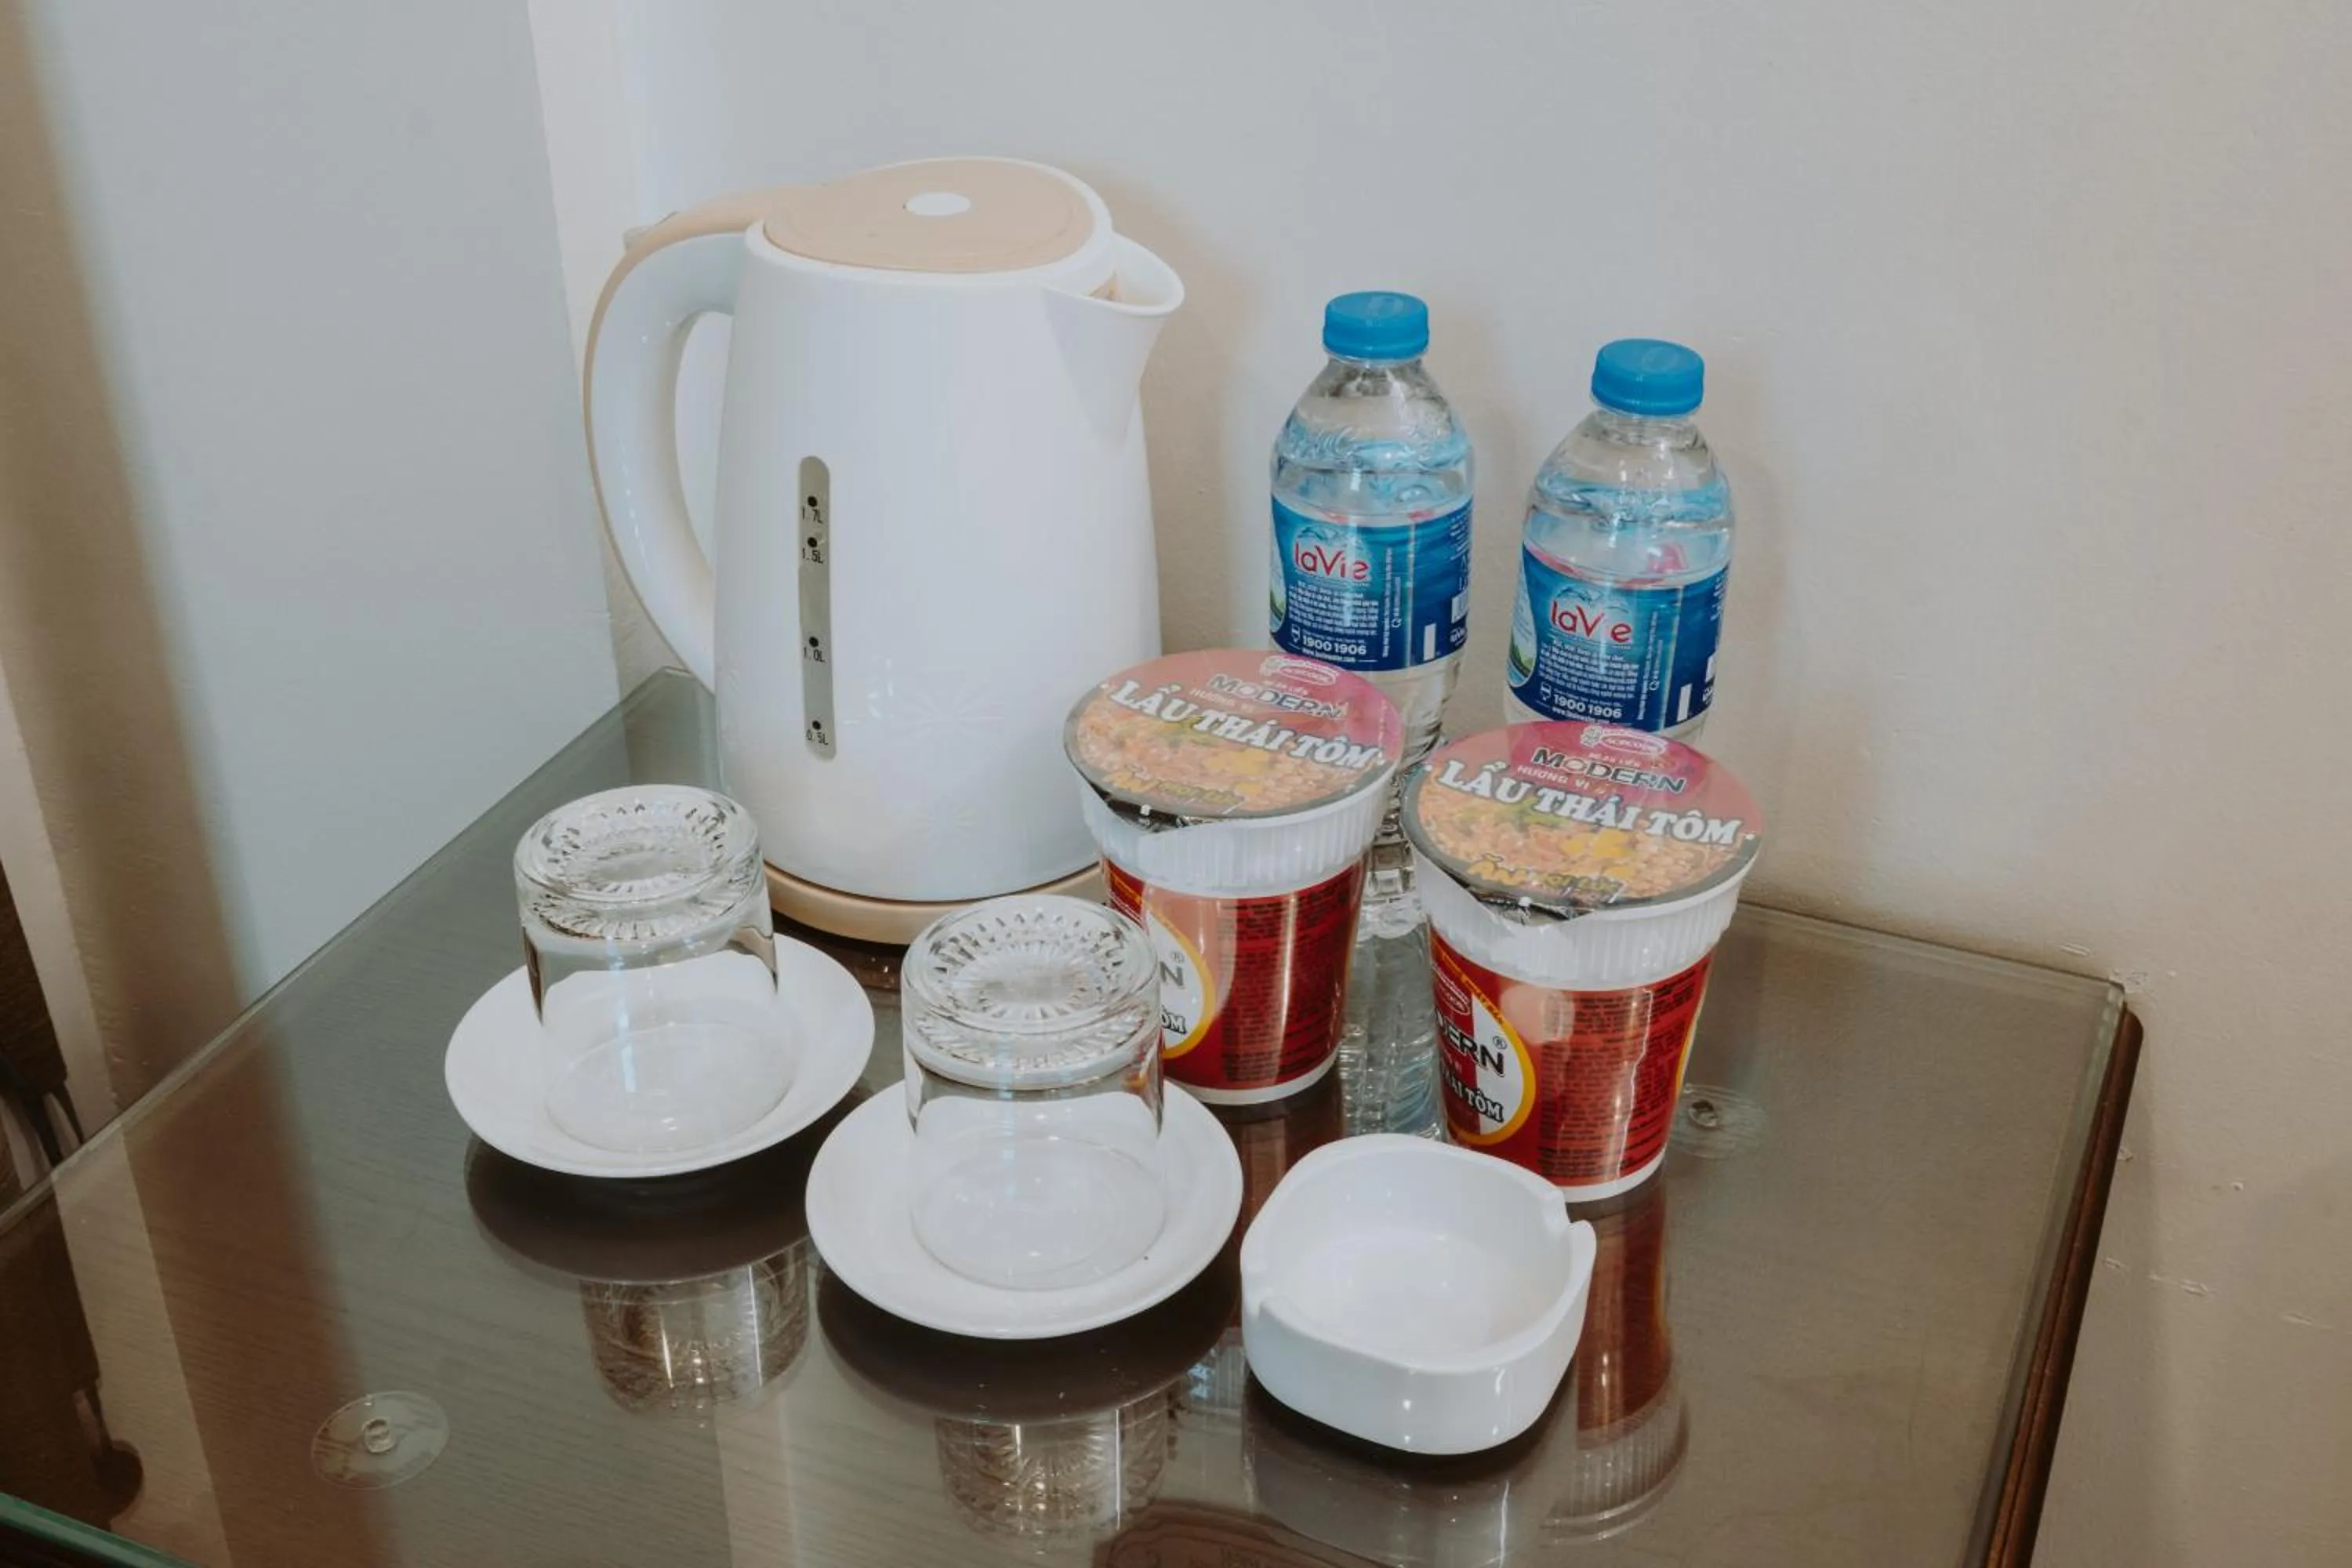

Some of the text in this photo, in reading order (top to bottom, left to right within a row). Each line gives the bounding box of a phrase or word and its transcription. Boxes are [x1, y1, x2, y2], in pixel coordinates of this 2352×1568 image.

[1294, 543, 1369, 581] laVie
[1550, 601, 1632, 643] laVe
[1302, 634, 1332, 652] 1900
[1334, 642, 1367, 655] 1906
[1208, 673, 1349, 720] MODERN
[1554, 694, 1585, 713] 1900
[1588, 704, 1623, 719] 1906
[1193, 709, 1294, 750] THÁI
[1290, 735, 1380, 768] TÔM
[1530, 746, 1686, 793] MODERN
[1533, 787, 1642, 830] THÁI
[1646, 809, 1742, 844] TÔM
